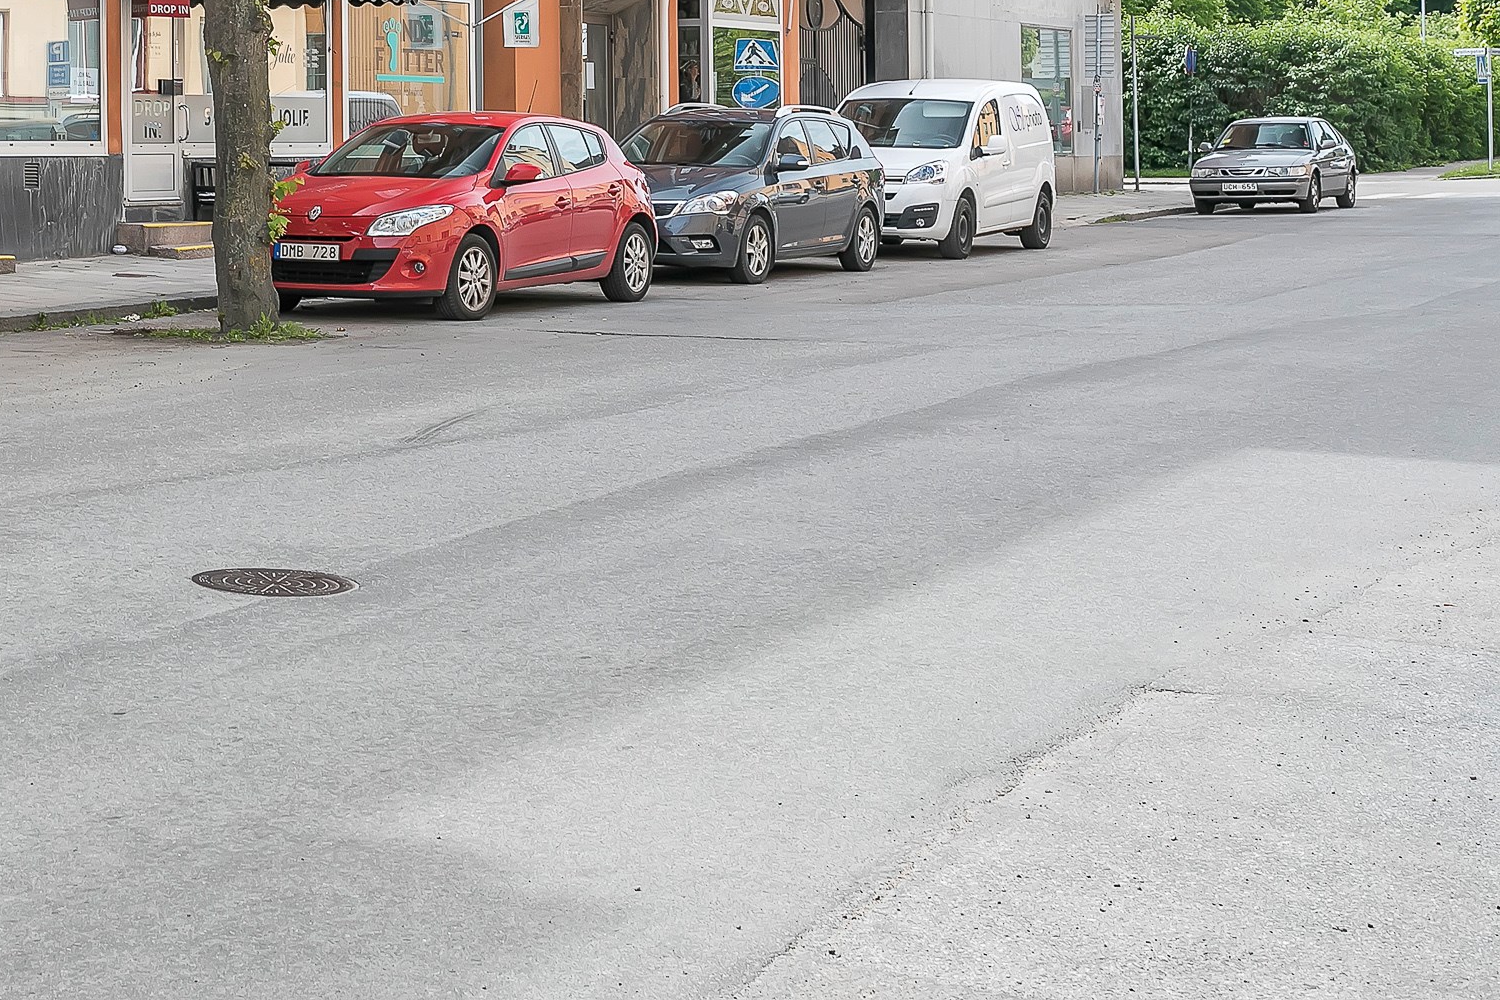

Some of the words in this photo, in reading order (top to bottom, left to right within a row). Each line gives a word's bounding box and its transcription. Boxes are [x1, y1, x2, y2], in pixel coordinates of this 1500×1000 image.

[150, 4, 177, 14] DROP
[178, 5, 189, 15] IN
[134, 99, 171, 117] DROP
[281, 244, 304, 258] DMB
[312, 245, 336, 259] 728
